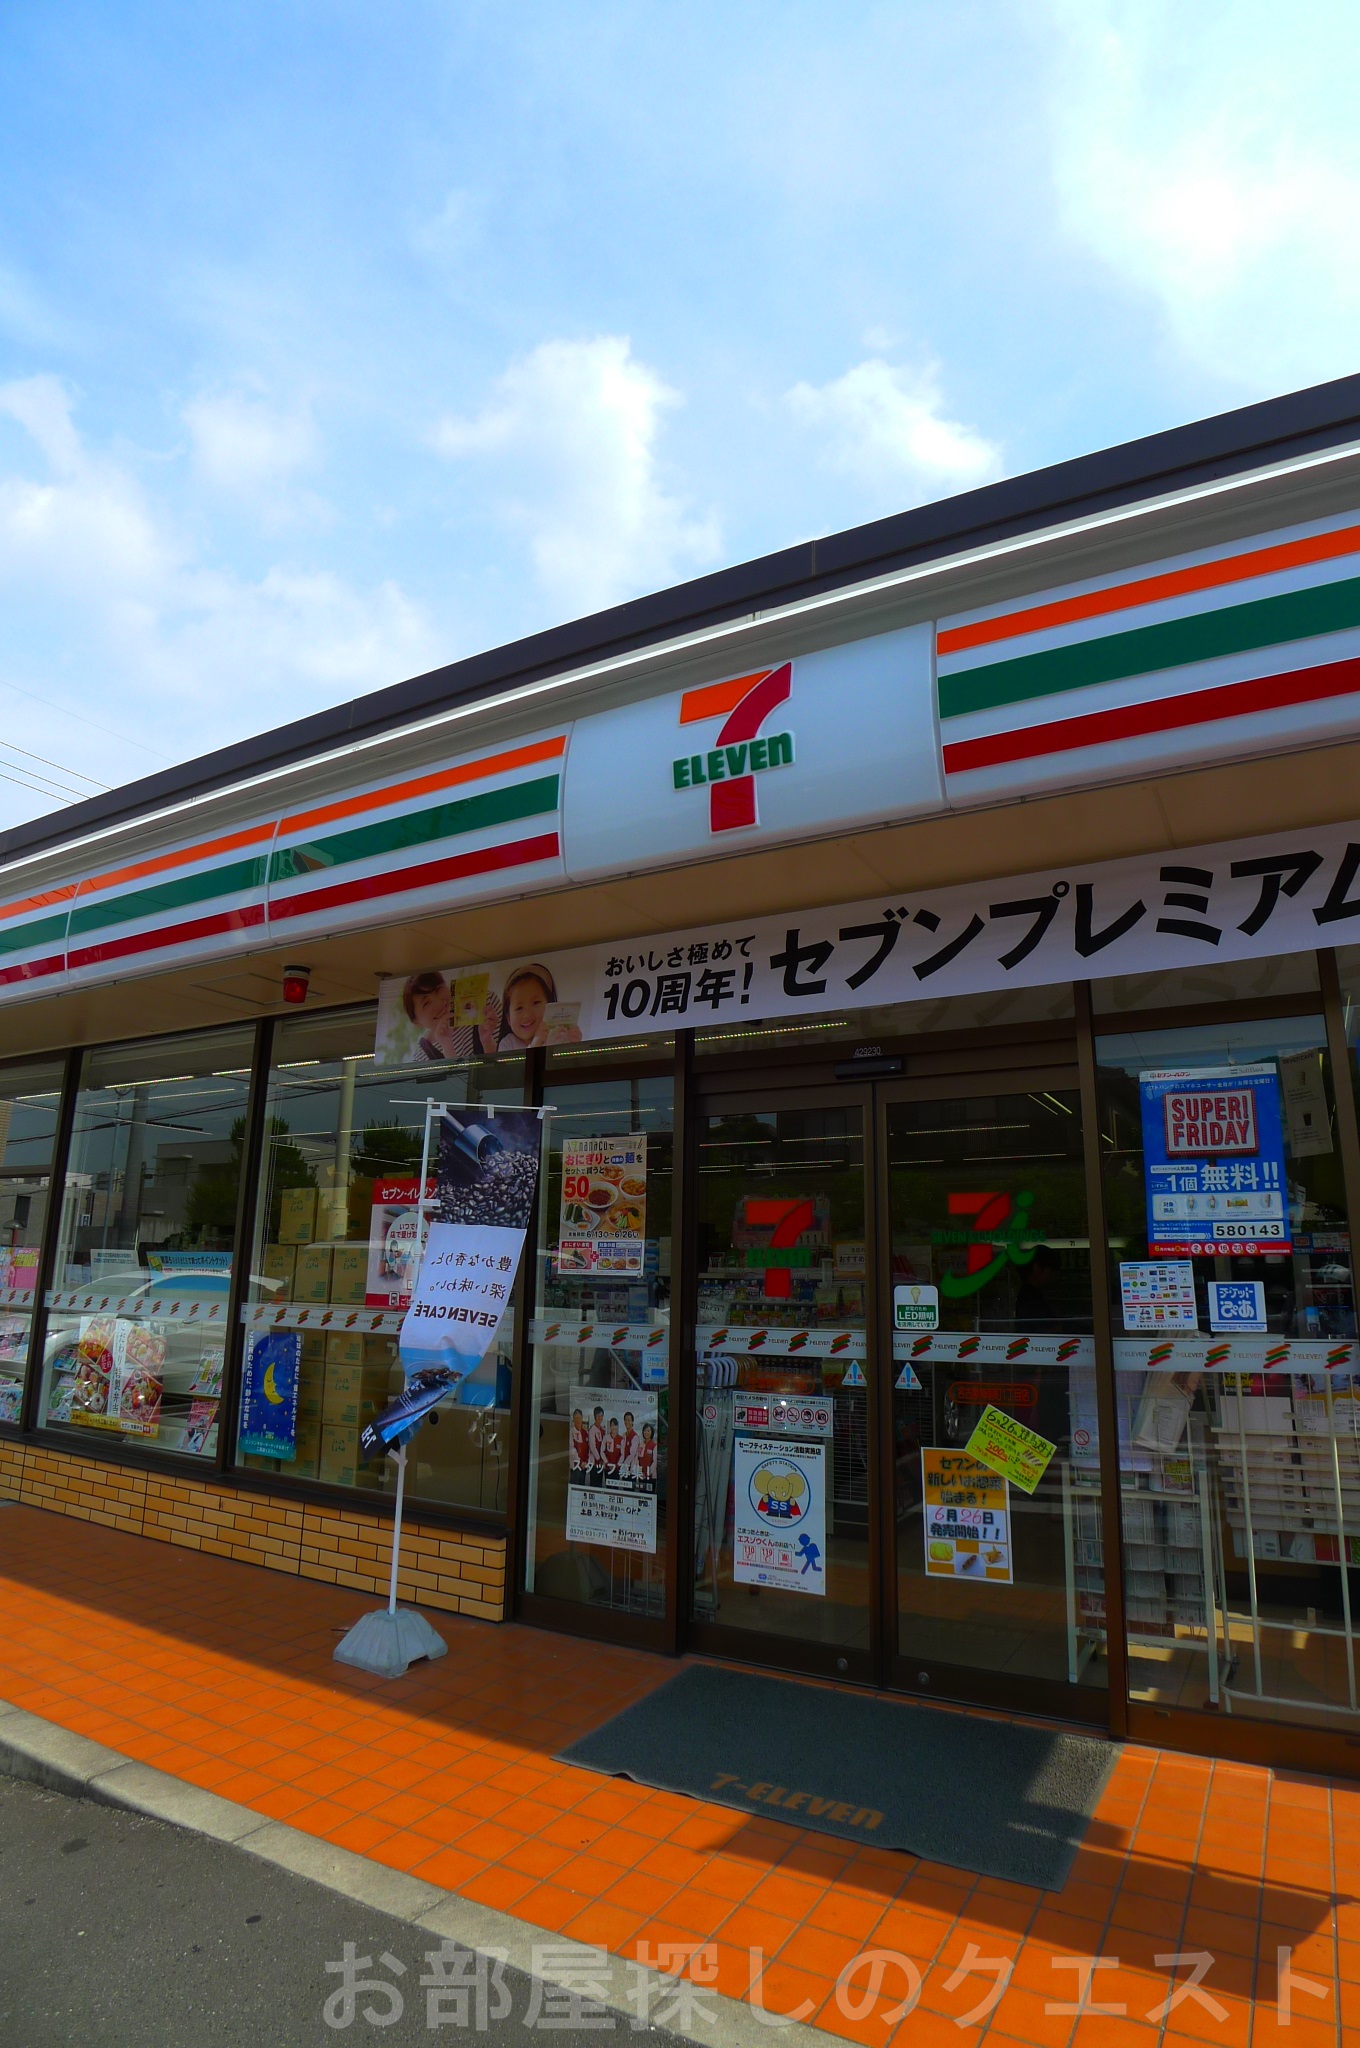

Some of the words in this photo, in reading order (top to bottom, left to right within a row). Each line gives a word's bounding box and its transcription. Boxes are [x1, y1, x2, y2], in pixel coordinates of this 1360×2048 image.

[604, 935, 756, 977] おいしさ極めて
[603, 961, 753, 1021] 10周年!
[854, 1046, 882, 1056] 429230
[1238, 1067, 1264, 1075] SoftBank
[1171, 1095, 1249, 1122] SUPER!
[1172, 1120, 1250, 1147] FRIDAY
[565, 1166, 605, 1175] セットで買うと
[563, 1175, 590, 1198] 50
[1166, 1174, 1197, 1192] 1個
[389, 1231, 428, 1239] 店で受け取る
[1216, 1224, 1280, 1238] 580143
[1219, 1286, 1254, 1299] チケット
[898, 1311, 935, 1321] LED照明
[1220, 1299, 1255, 1318] ぴあ
[739, 1441, 822, 1455] セーフティステーション活動実施店
[572, 1459, 650, 1481] スタッフ募集!
[761, 1460, 778, 1470] SAFETY
[928, 1473, 1002, 1490] 新しいお惣菜
[771, 1501, 788, 1510] SS
[934, 1508, 994, 1524] 6月26日
